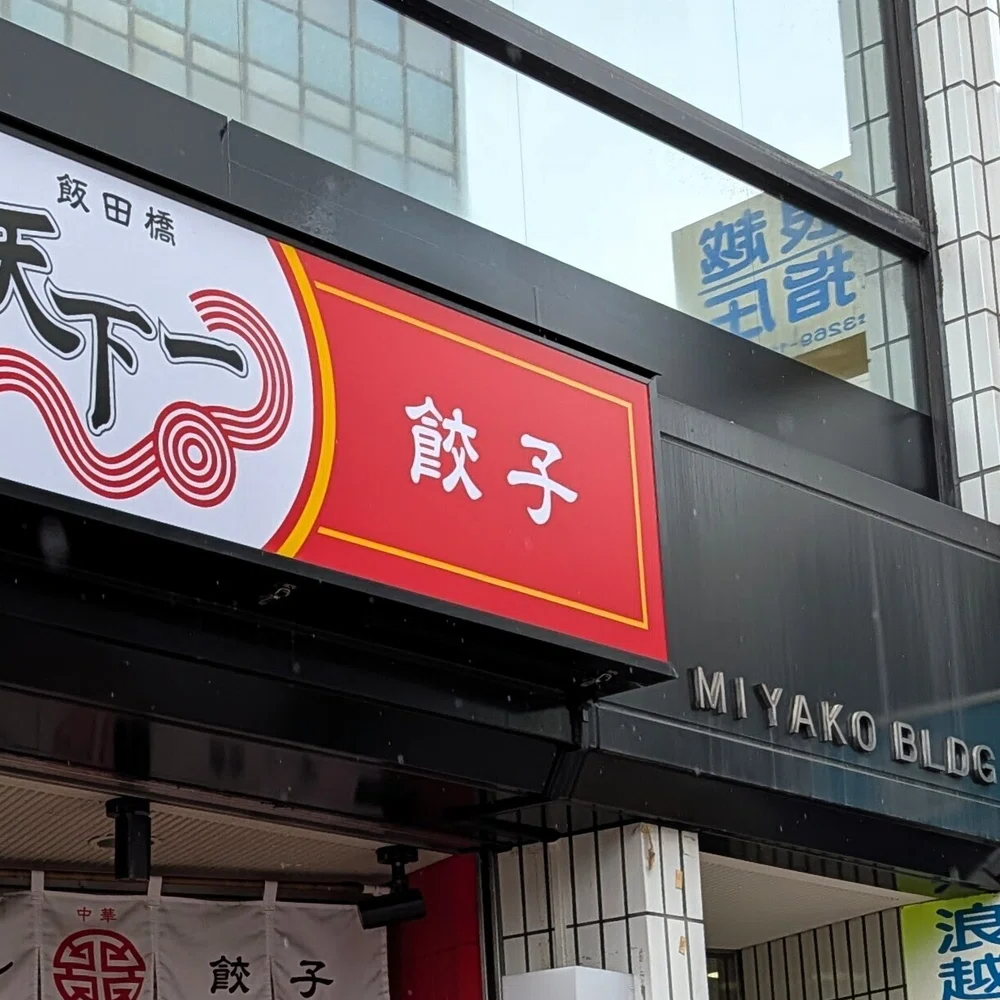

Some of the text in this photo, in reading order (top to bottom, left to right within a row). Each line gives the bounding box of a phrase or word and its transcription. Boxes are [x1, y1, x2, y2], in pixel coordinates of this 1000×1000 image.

[57, 174, 177, 247] 飯田橋
[404, 397, 578, 525] 餃子
[692, 666, 998, 784] MIYAKO BLDG
[77, 907, 117, 923] 中華
[209, 955, 334, 998] 餃子
